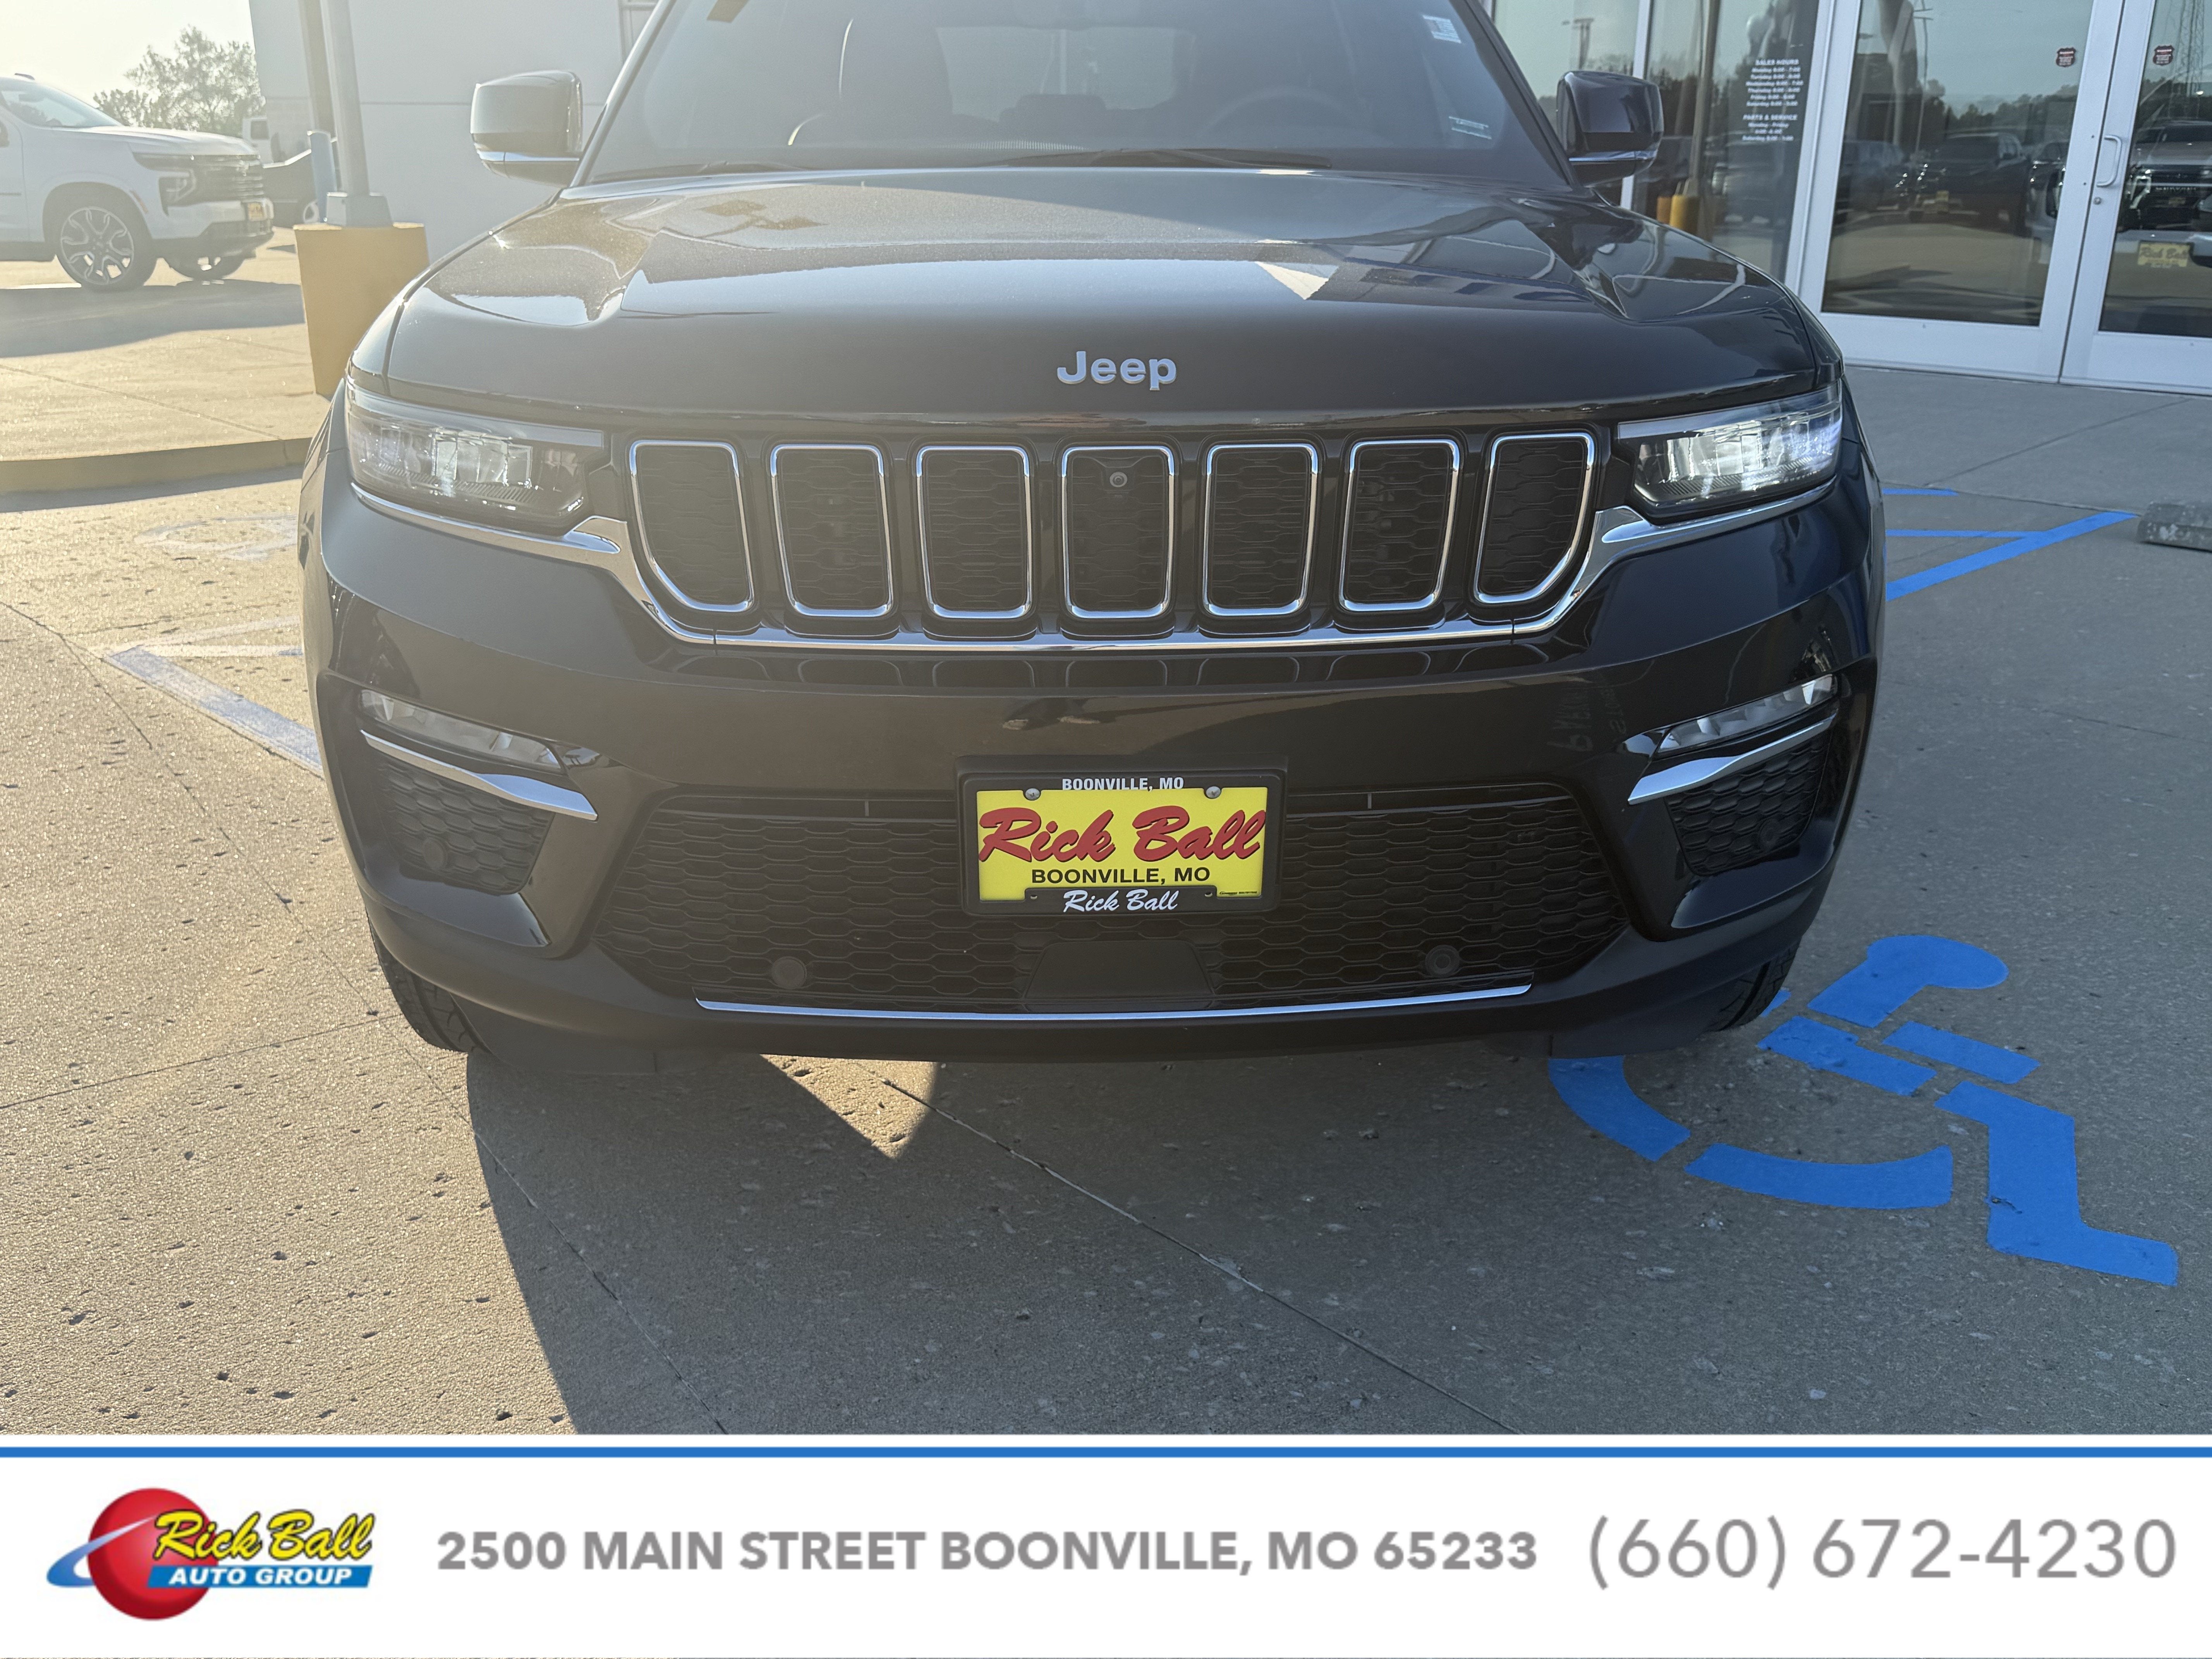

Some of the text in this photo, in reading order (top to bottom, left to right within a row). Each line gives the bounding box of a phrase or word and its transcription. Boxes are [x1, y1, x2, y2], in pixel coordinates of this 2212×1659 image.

[1057, 351, 1176, 390] Jeep
[1062, 777, 1184, 791] BOONVILLE, MO
[979, 805, 1266, 862] Rick Ball
[1032, 867, 1211, 886] BOONVILLE, MO
[1063, 889, 1179, 912] Rick Ball
